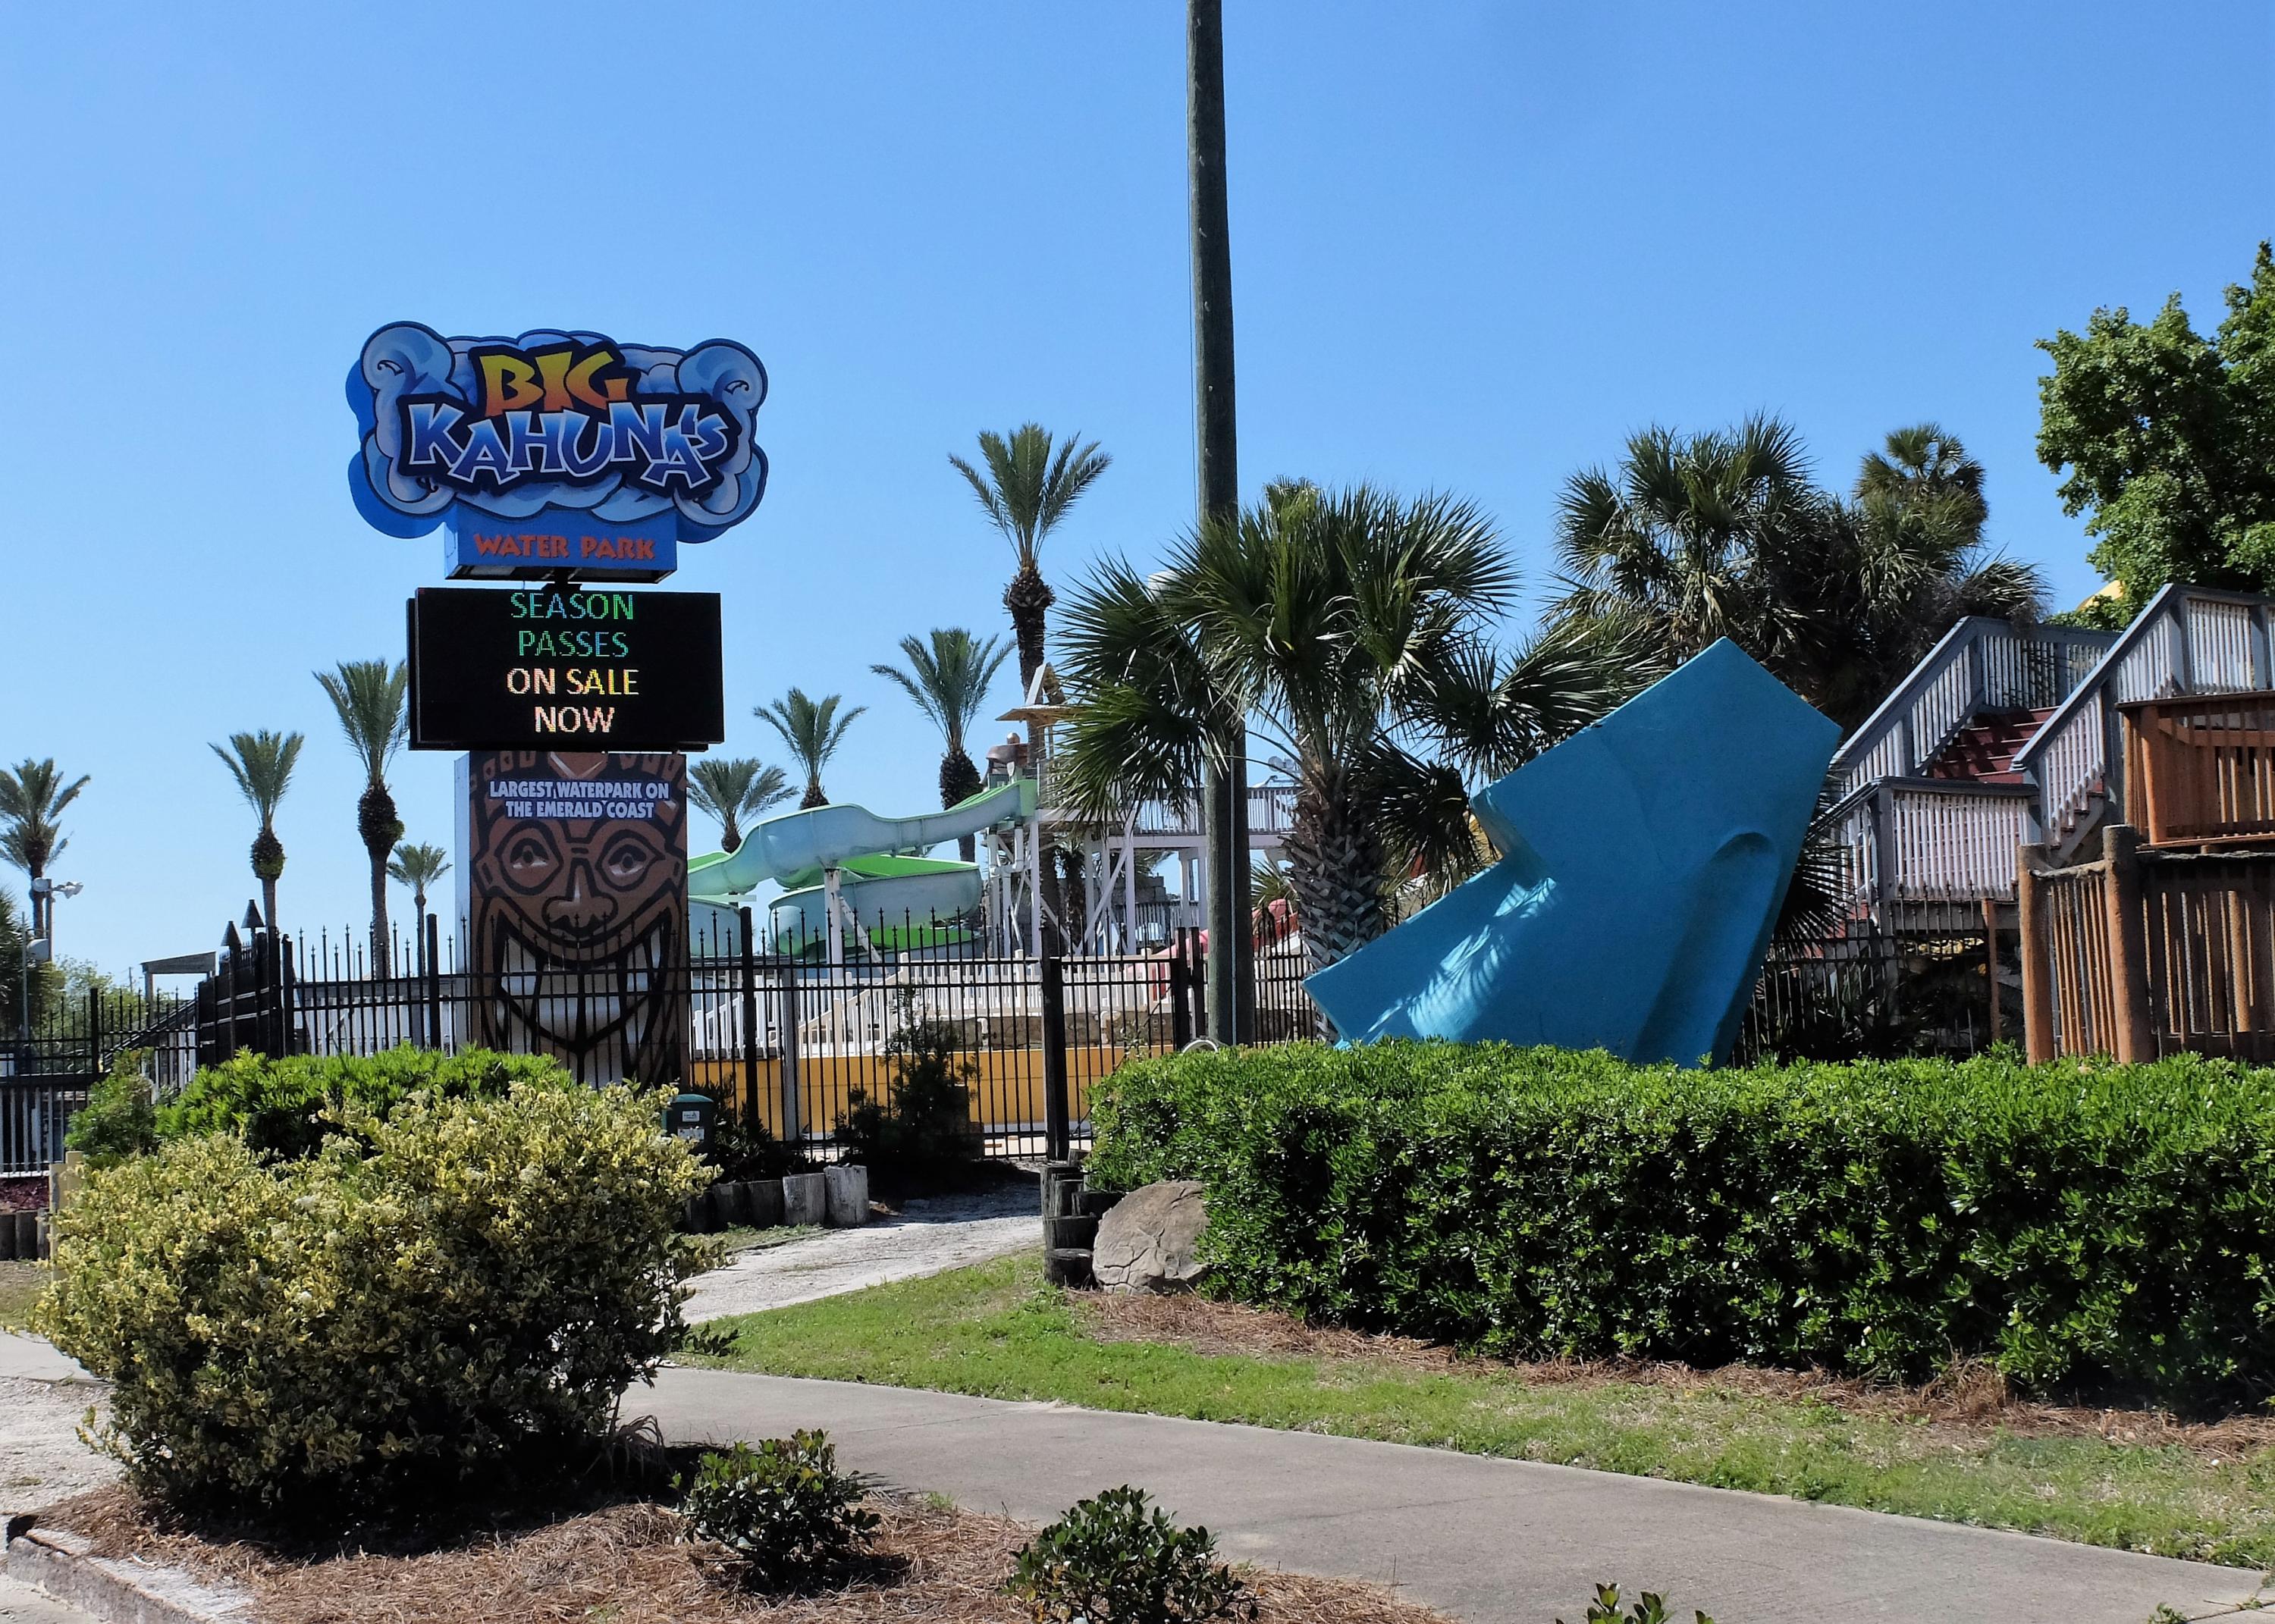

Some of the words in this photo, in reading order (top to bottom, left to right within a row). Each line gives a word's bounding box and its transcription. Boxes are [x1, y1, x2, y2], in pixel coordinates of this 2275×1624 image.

[479, 351, 629, 416] BIG
[408, 401, 730, 489] KAHUNA'S
[473, 534, 569, 560] WATER
[581, 537, 655, 560] PARK
[510, 592, 633, 619] SEASON
[519, 631, 629, 657] PASSES
[507, 668, 555, 694] ON
[566, 669, 639, 695] SALE
[535, 706, 615, 732] NOW
[490, 781, 554, 798] LARGEST
[557, 782, 642, 798] WATERPARK
[645, 782, 669, 799] ON
[506, 801, 532, 818] THE
[536, 801, 603, 819] EMERALD
[607, 802, 654, 819] COAST
